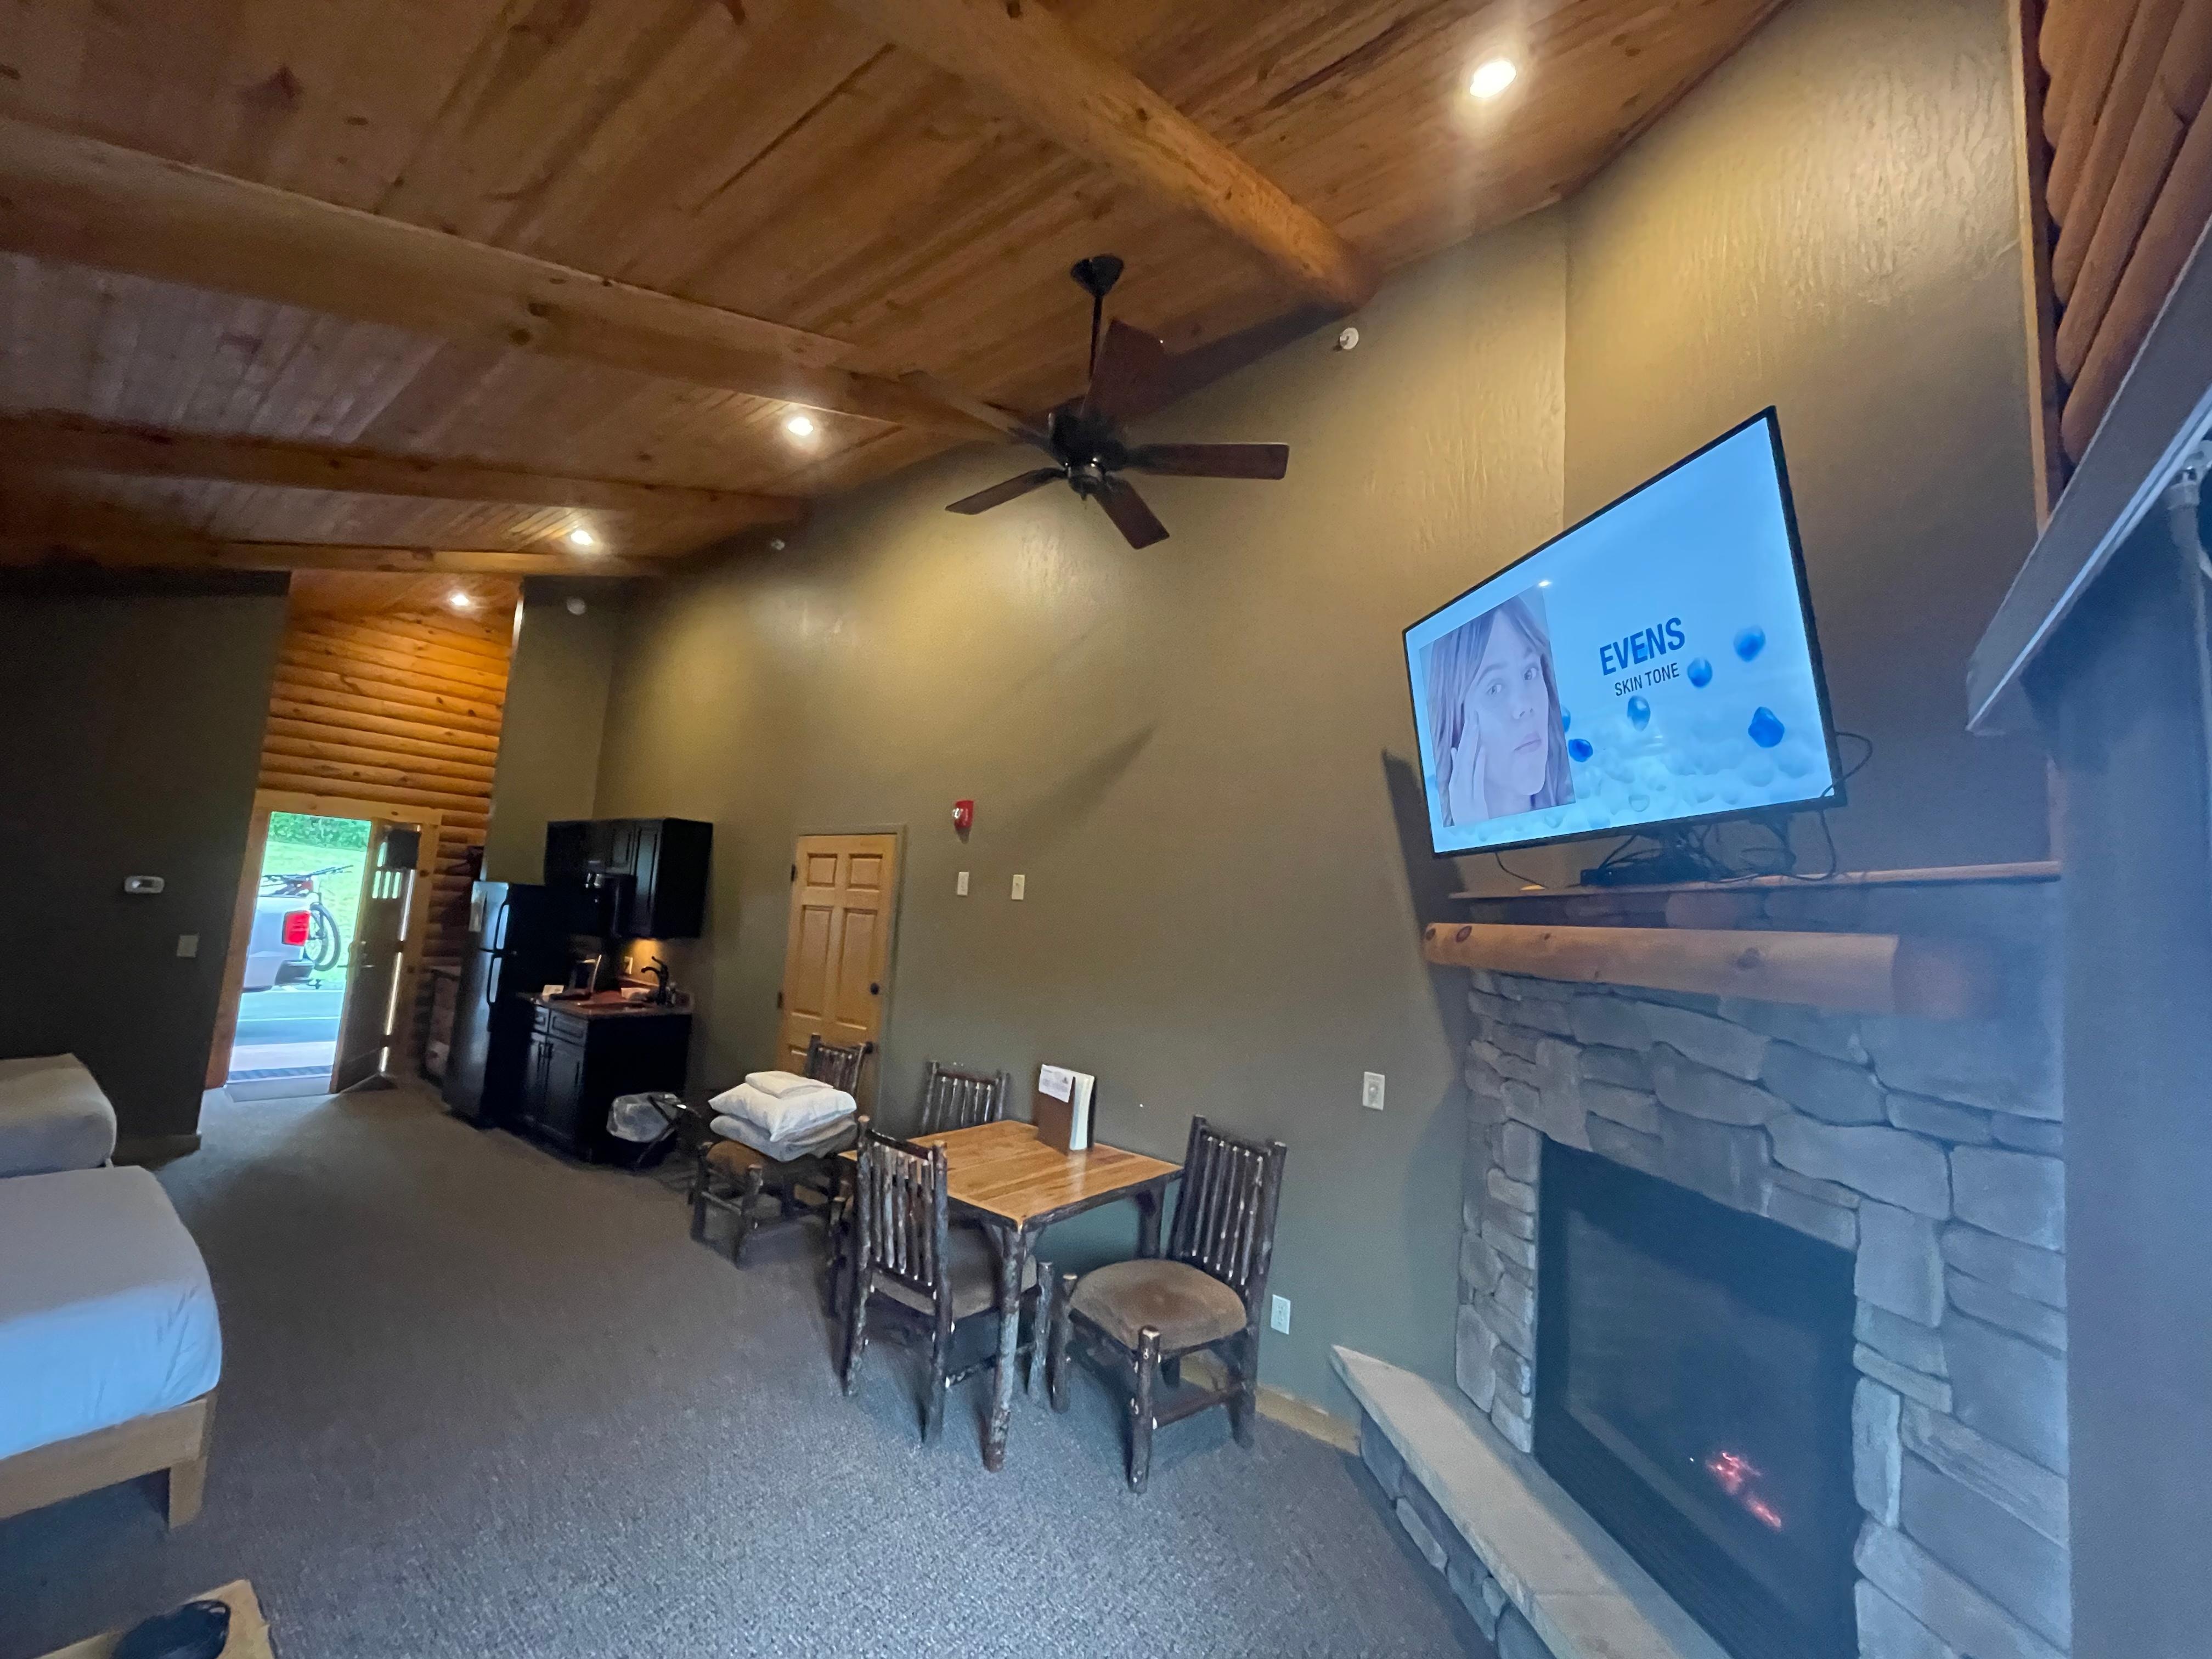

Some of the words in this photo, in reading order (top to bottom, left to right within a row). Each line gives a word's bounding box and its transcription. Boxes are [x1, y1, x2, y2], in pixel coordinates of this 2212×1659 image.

[1599, 617, 1685, 676] EVENS
[1615, 675, 1643, 696] SKIN
[1645, 662, 1680, 686] TONE
